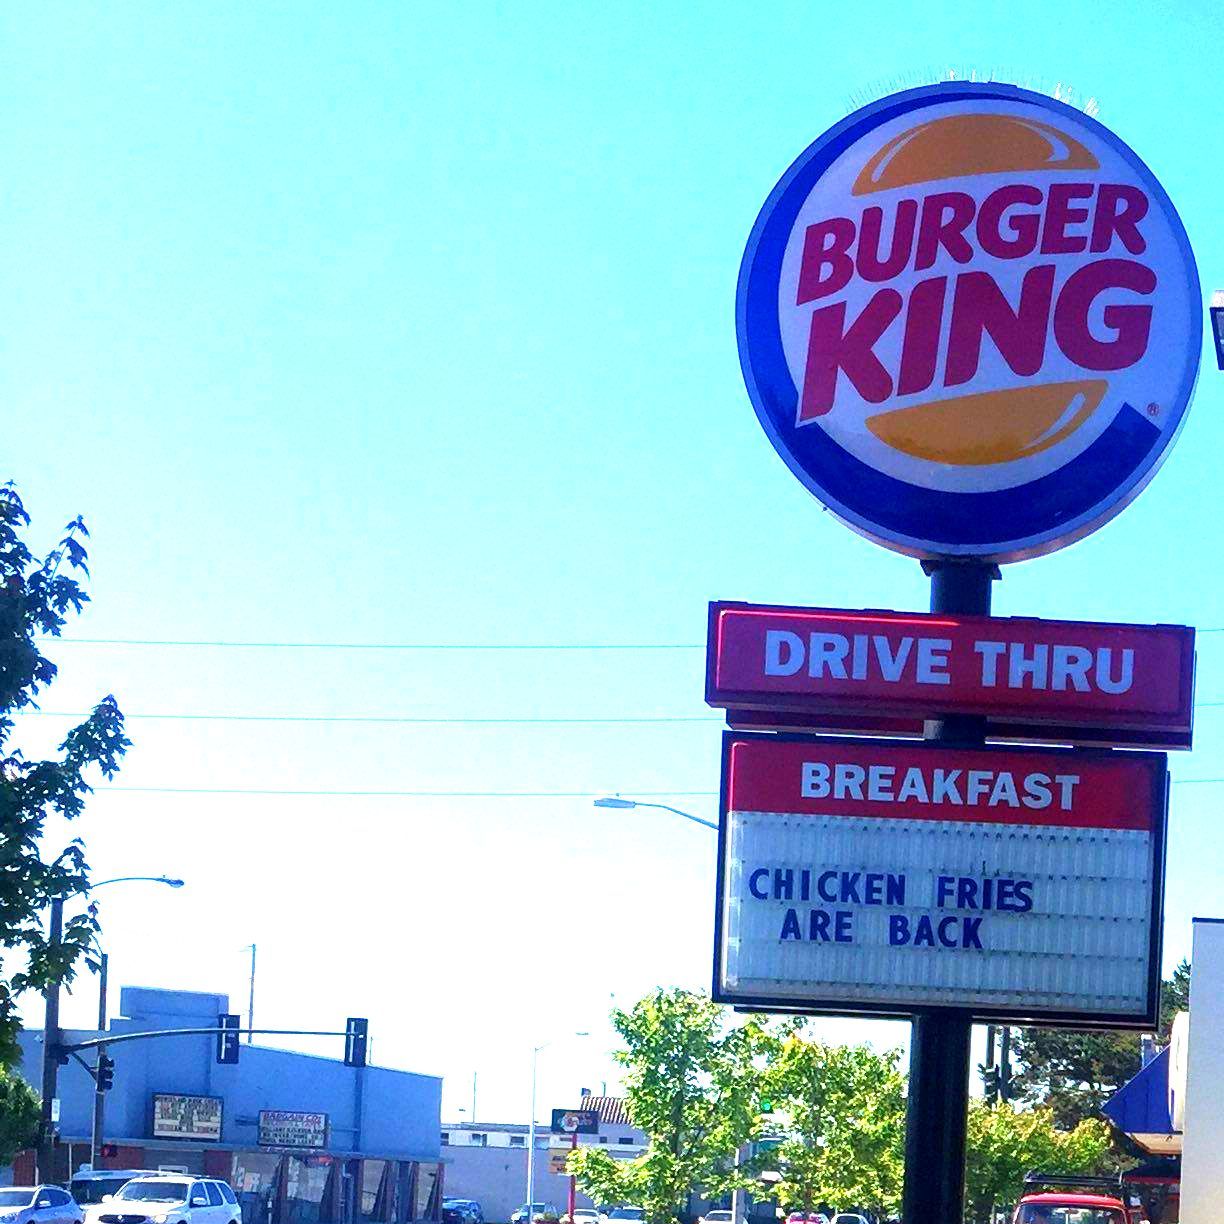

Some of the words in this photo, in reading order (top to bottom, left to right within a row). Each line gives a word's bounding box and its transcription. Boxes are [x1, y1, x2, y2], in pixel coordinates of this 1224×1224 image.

[797, 183, 1148, 305] BURGER
[797, 259, 1156, 422] KING
[765, 630, 952, 685] DRIVE
[974, 641, 1135, 695] THRU
[801, 762, 1080, 811] BREAKFAST
[749, 868, 906, 906] CHICKEN
[937, 876, 1034, 913] FRIES
[781, 908, 853, 942] ARE
[890, 915, 984, 949] BACK
